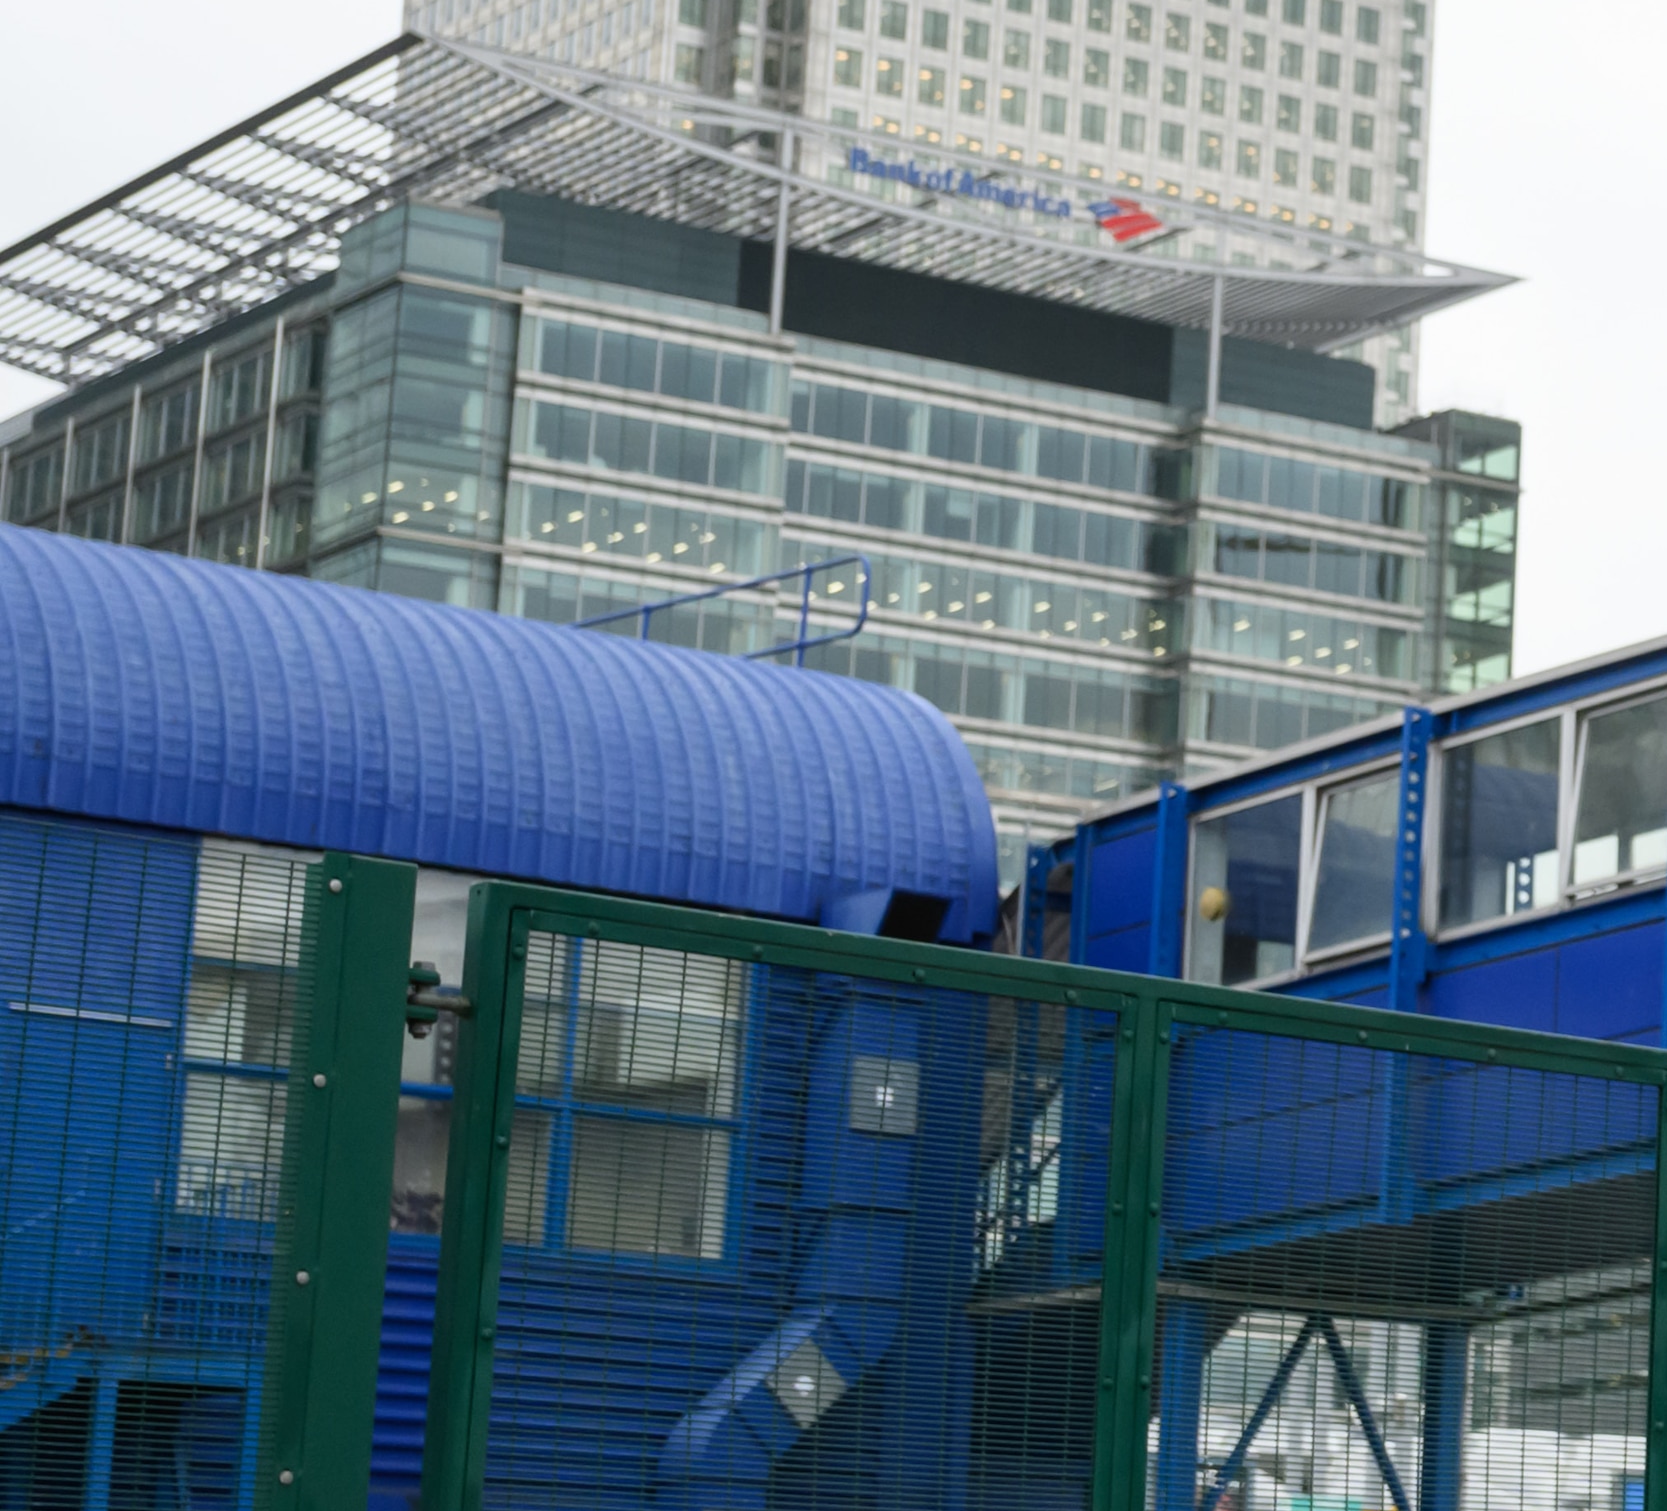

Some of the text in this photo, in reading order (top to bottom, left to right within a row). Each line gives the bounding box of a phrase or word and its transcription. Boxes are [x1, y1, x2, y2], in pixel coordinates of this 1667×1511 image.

[852, 147, 1072, 218] Bank of America
